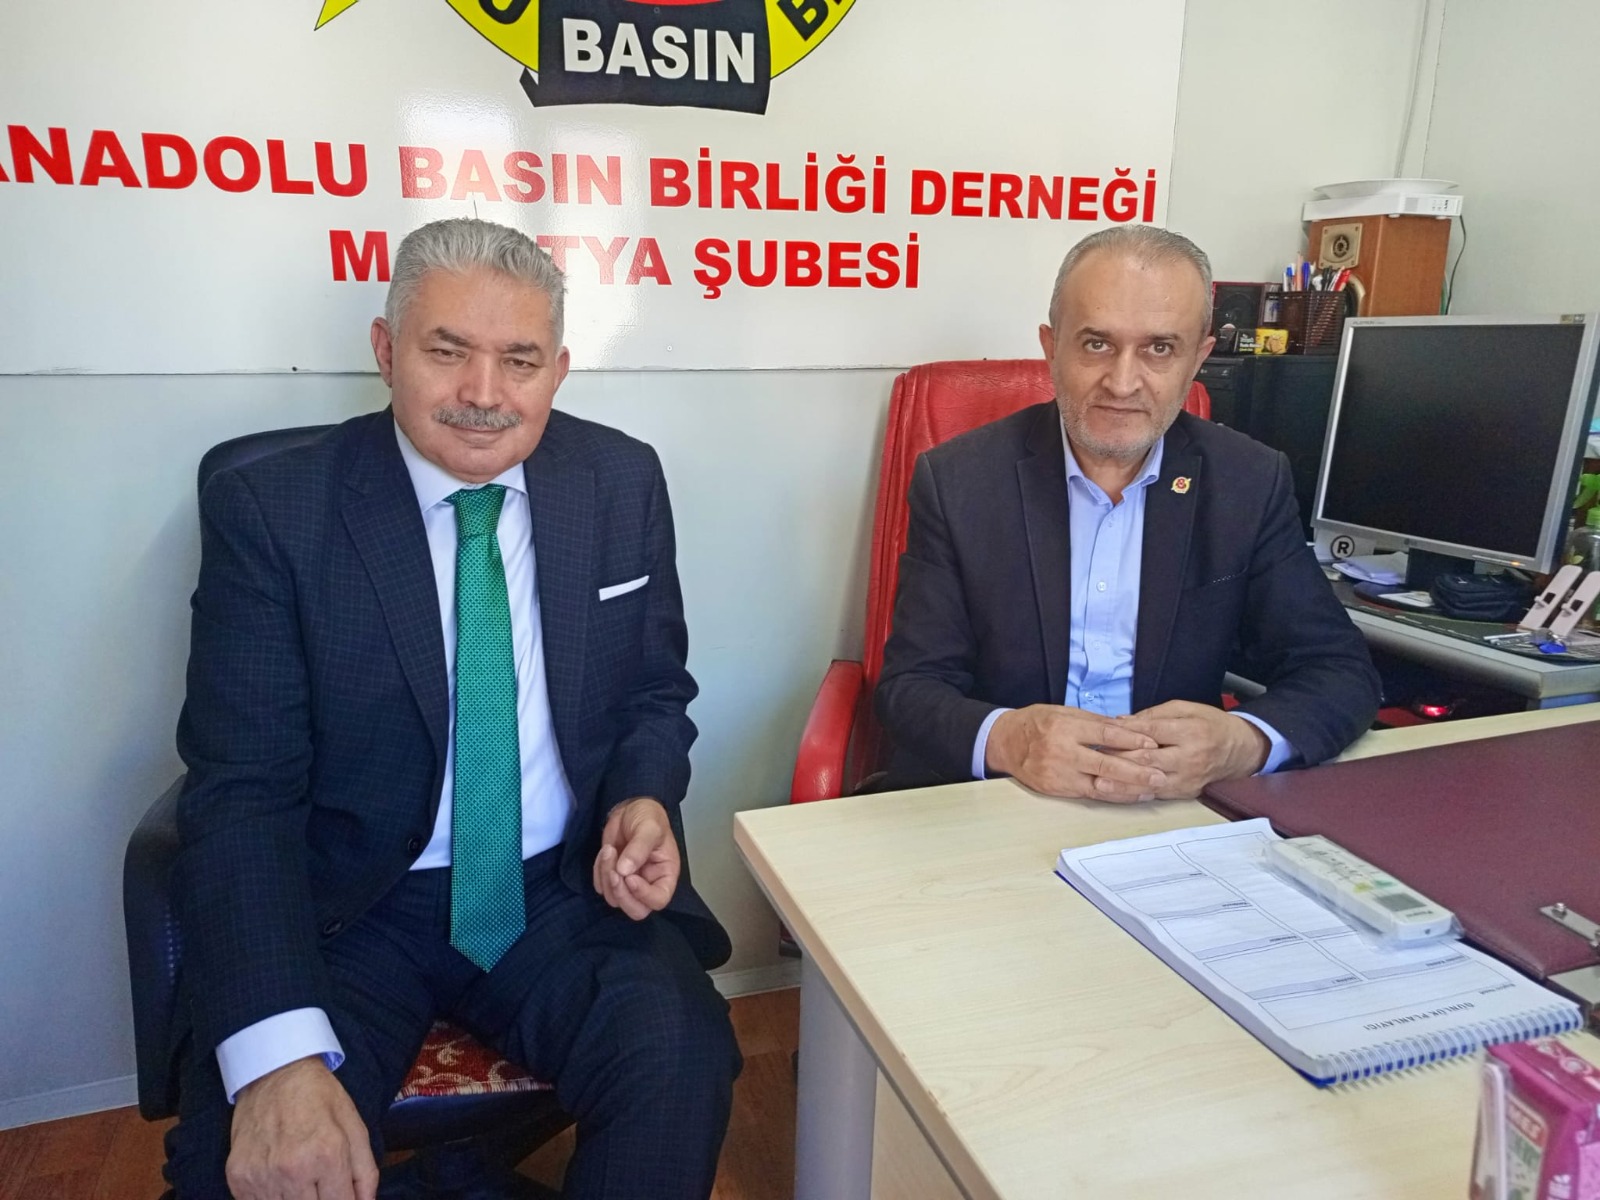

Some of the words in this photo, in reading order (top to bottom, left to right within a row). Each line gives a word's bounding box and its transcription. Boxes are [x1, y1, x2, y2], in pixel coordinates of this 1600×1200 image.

[562, 18, 756, 84] BASIN
[0, 125, 368, 197] NADOLU
[399, 145, 624, 206] BASIN
[649, 147, 888, 215] BİRLİĞİ
[910, 167, 1158, 223] DERNEĞİ
[329, 229, 671, 286] MTYA
[693, 232, 920, 299] ŞUBESİ
